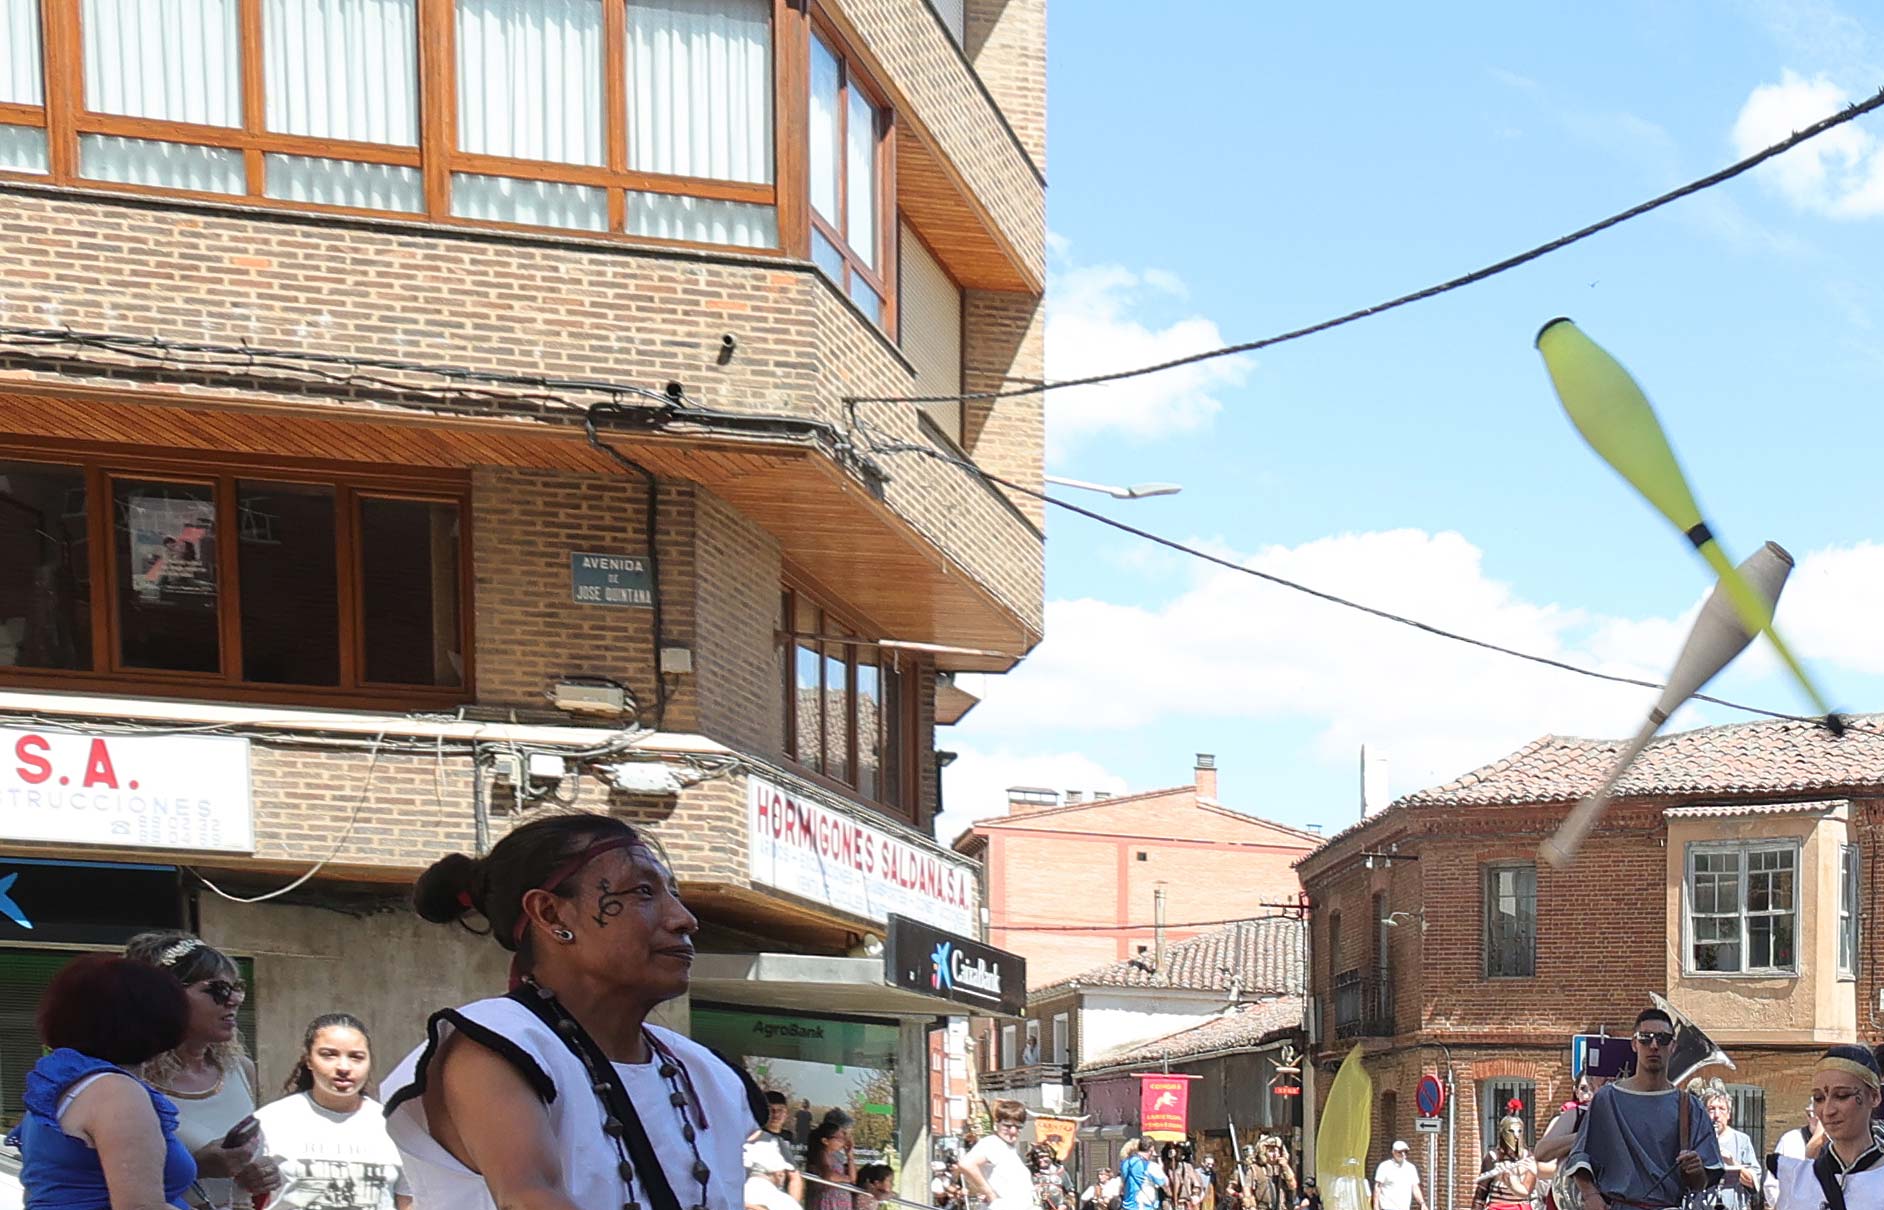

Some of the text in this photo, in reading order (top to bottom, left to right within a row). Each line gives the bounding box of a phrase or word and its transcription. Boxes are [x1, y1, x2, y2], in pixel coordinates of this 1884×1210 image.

[582, 557, 644, 572] AVENIDA
[605, 587, 652, 604] QUINTANA
[15, 734, 140, 790] S.A.
[0, 788, 212, 817] TRUCCIONES
[758, 786, 874, 874] HORMIGONES
[951, 949, 1001, 994] CaixaBank
[752, 1020, 824, 1039] AgroBank
